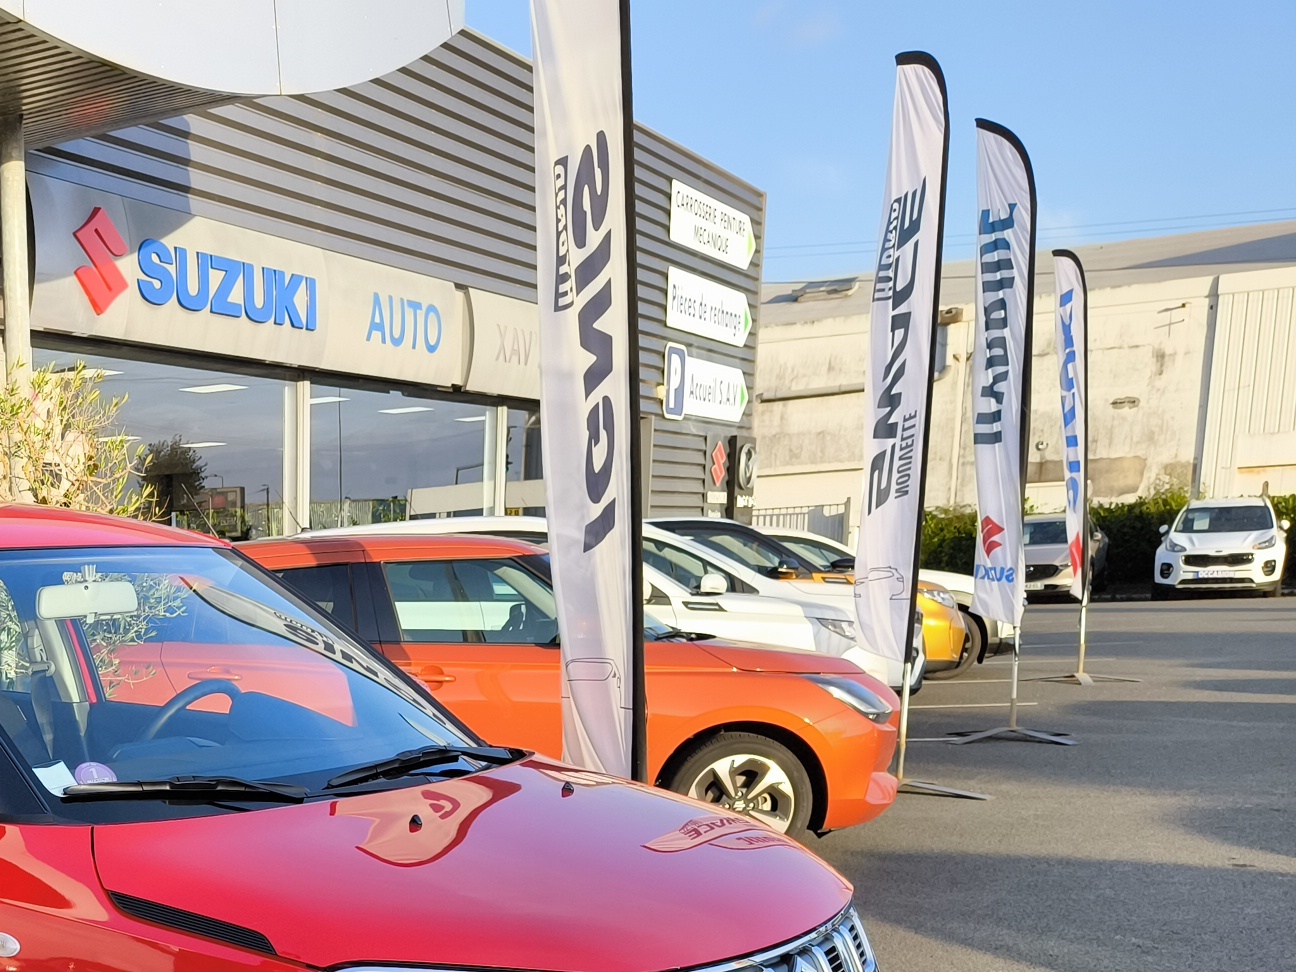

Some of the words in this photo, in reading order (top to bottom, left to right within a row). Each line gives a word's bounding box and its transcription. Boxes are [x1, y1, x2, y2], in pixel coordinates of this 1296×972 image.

[676, 190, 716, 225] CARROSSERIE
[720, 211, 745, 238] PEINTURE
[694, 224, 729, 254] MECANIQUE
[136, 238, 317, 332] SUZUKI
[365, 291, 442, 354] AUTO
[671, 284, 696, 317] Pièces
[698, 293, 707, 321] de
[709, 300, 742, 337] rechange
[494, 323, 538, 367] XAV
[668, 353, 682, 409] P
[689, 373, 717, 405] Accueil
